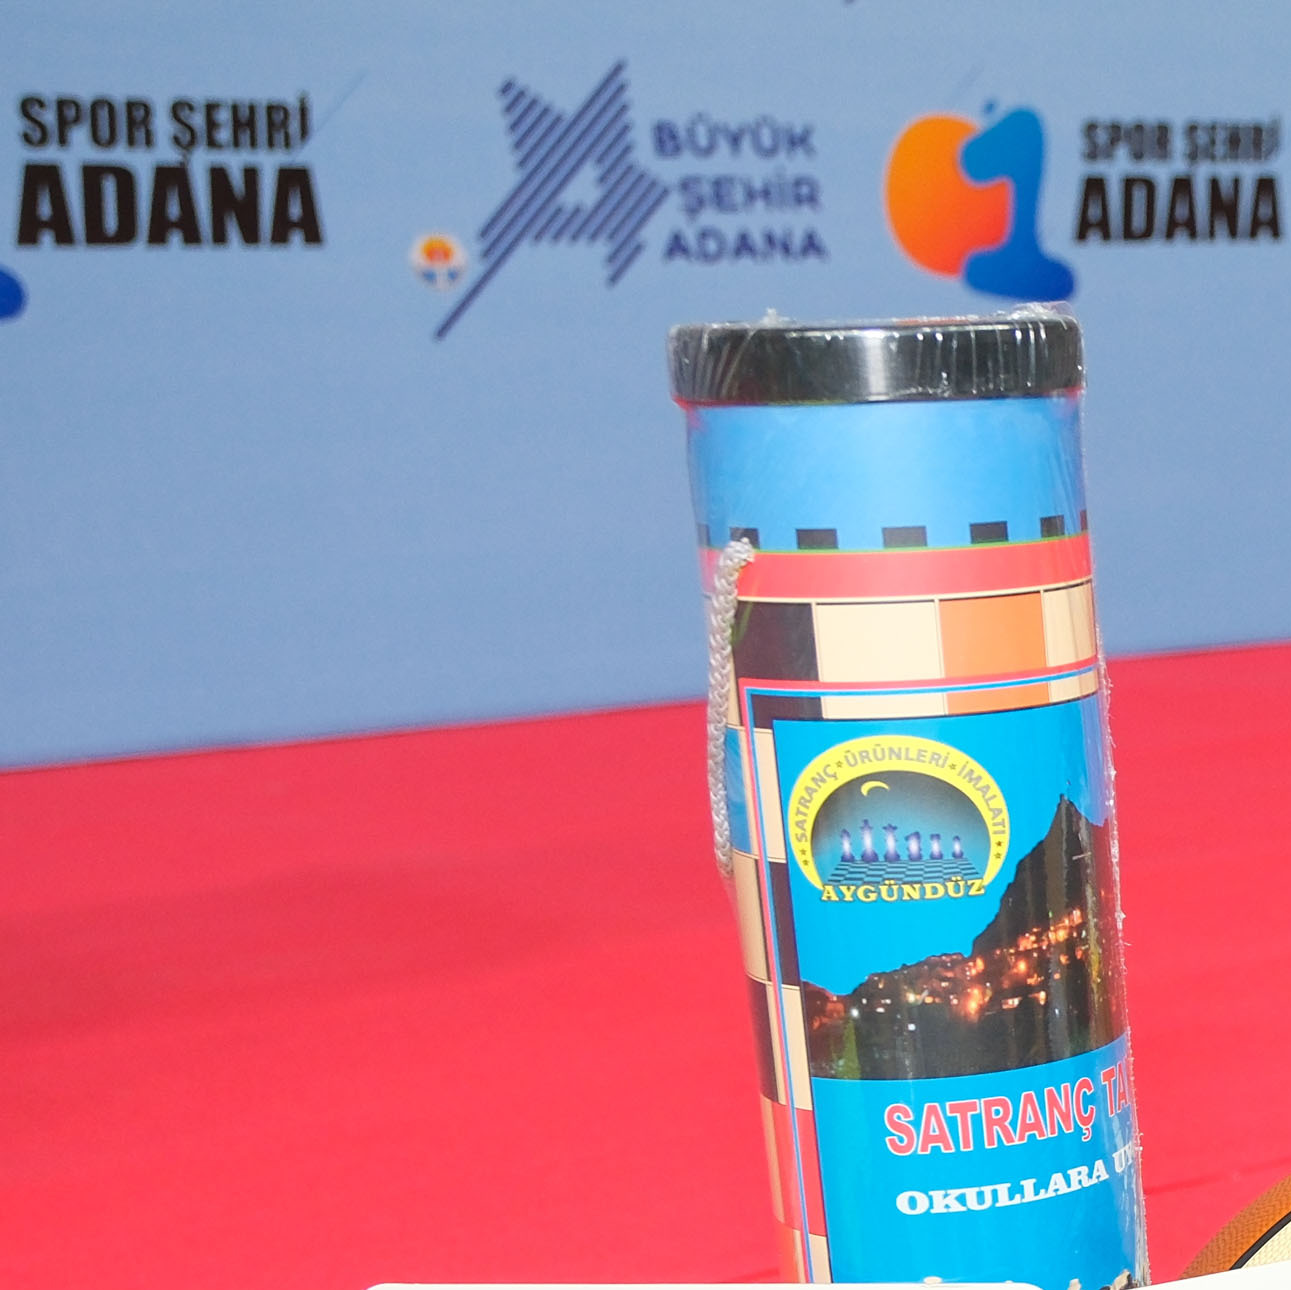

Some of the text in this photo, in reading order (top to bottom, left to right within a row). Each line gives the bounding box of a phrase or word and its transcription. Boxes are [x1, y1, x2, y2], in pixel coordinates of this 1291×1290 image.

[20, 91, 312, 163] SPOR ŞEHRİ
[653, 113, 816, 159] BÜYÜK
[1082, 120, 1169, 164] SPOR
[17, 164, 323, 247] ADANA
[677, 168, 821, 219] ŞEHİR
[1076, 175, 1282, 242] ADANA
[664, 228, 827, 264] ADANA
[794, 744, 1006, 843] SATRANÇ ÜRÜNLERİ İMALATI
[820, 875, 986, 903] AYGÜNDÜZ
[884, 1077, 1096, 1156] SATRANÇ
[895, 1158, 1110, 1216] OKULLARA
